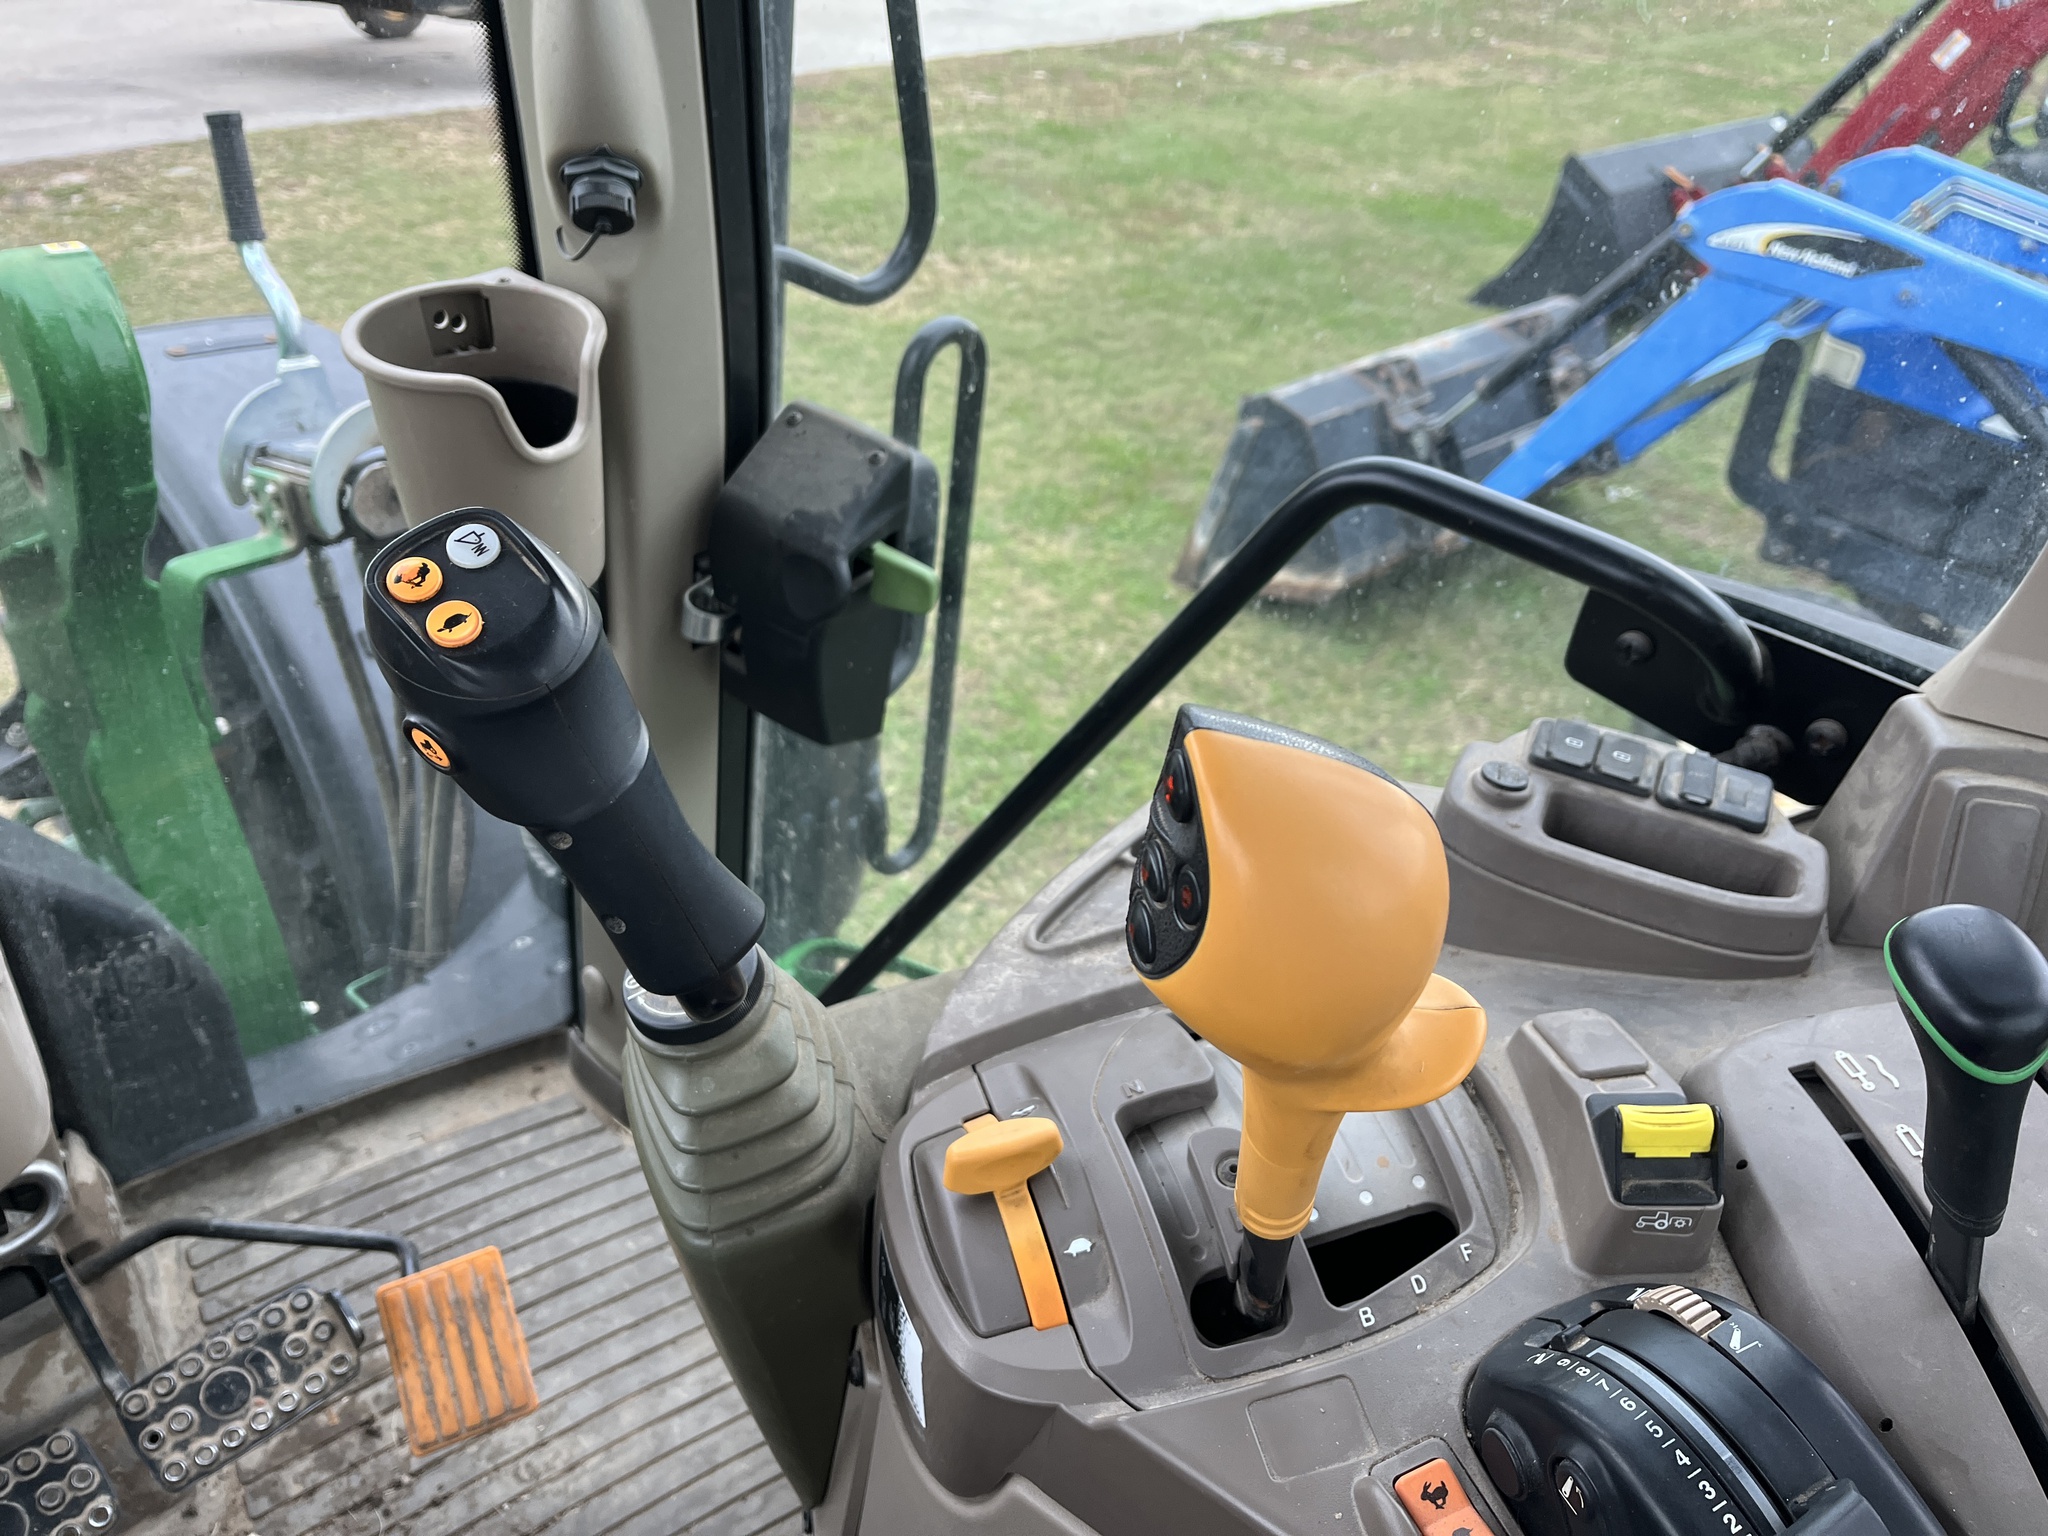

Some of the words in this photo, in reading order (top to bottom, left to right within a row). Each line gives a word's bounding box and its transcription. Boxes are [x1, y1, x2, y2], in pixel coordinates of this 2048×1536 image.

[1121, 1079, 1145, 1098] N
[1358, 1306, 1376, 1328] B
[1410, 1274, 1427, 1295] D
[1459, 1243, 1473, 1262] F
[1575, 1366, 1591, 1377] 8
[1595, 1378, 1610, 1392] 7
[1619, 1396, 1637, 1412] 6
[1644, 1420, 1664, 1438] 5
[1675, 1449, 1692, 1466] 4
[1698, 1480, 1716, 1500] 3
[1722, 1513, 1743, 1535] 2
